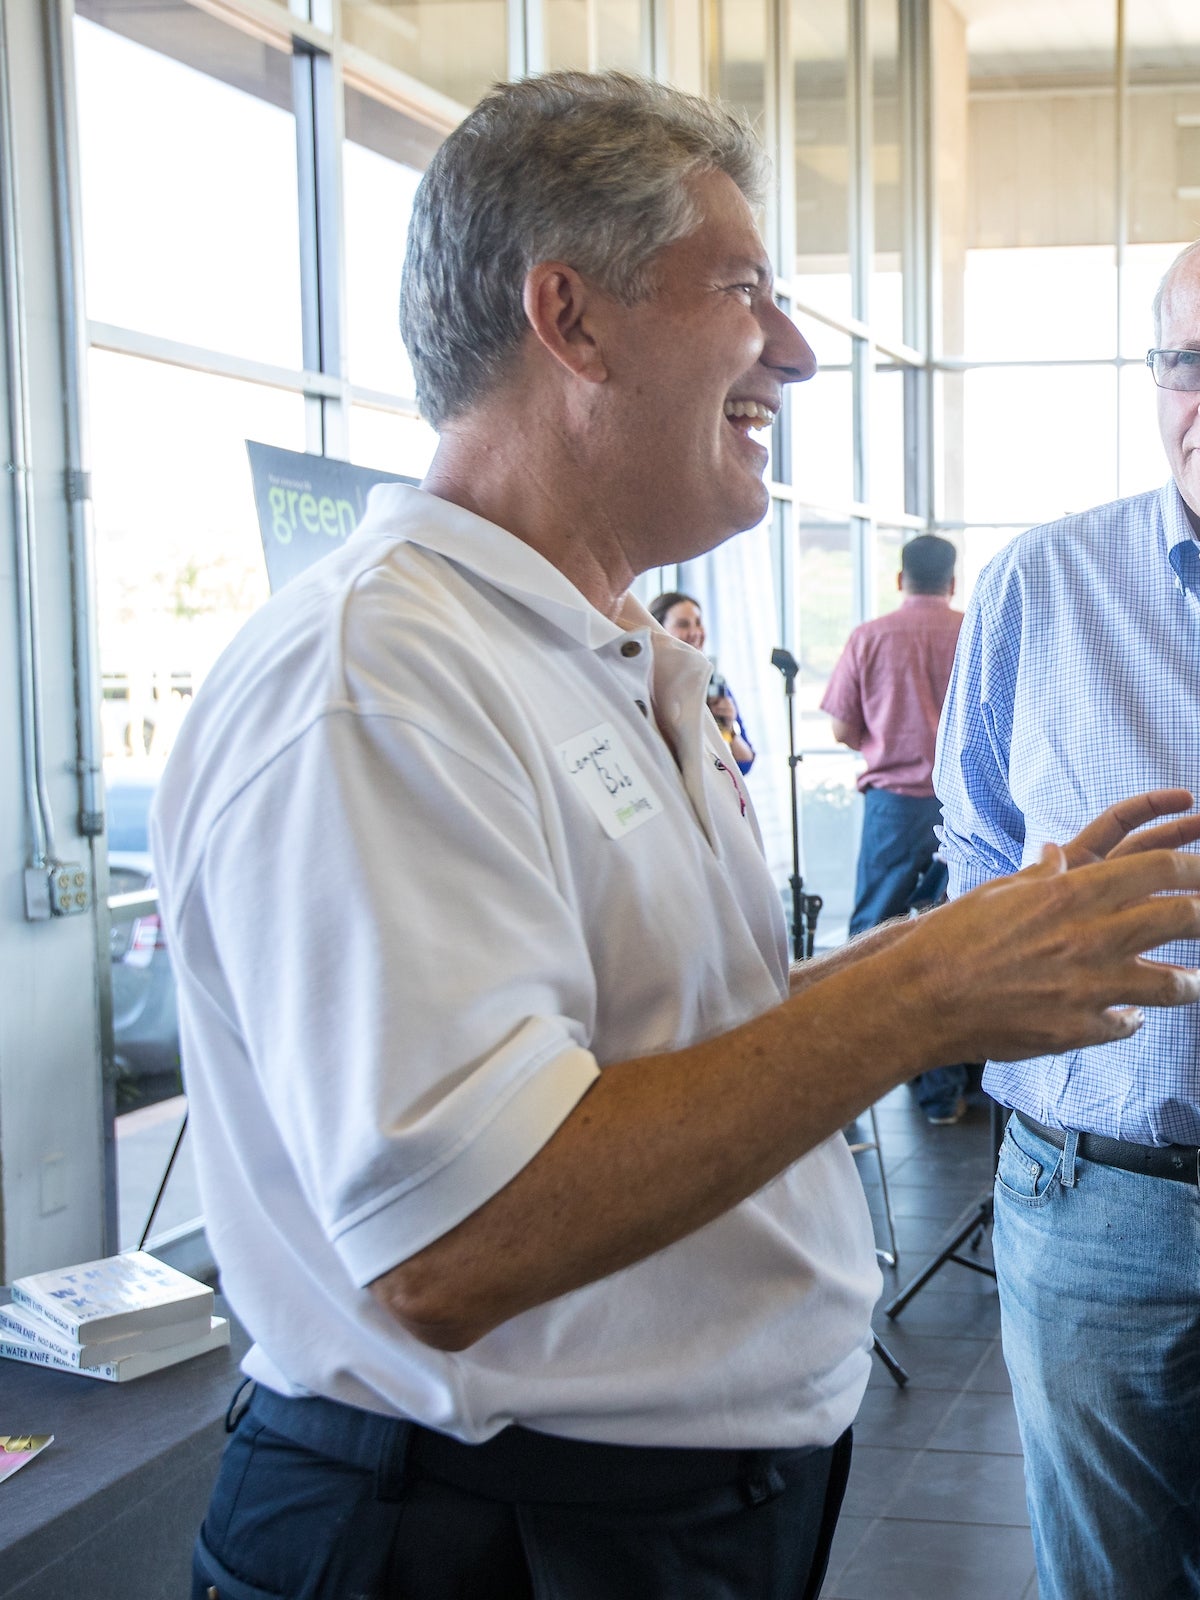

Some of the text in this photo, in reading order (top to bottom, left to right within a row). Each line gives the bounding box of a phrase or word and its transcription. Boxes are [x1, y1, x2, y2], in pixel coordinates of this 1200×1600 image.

[268, 486, 357, 545] green
[6, 1345, 28, 1359] WATER
[29, 1350, 49, 1364] KNIFE
